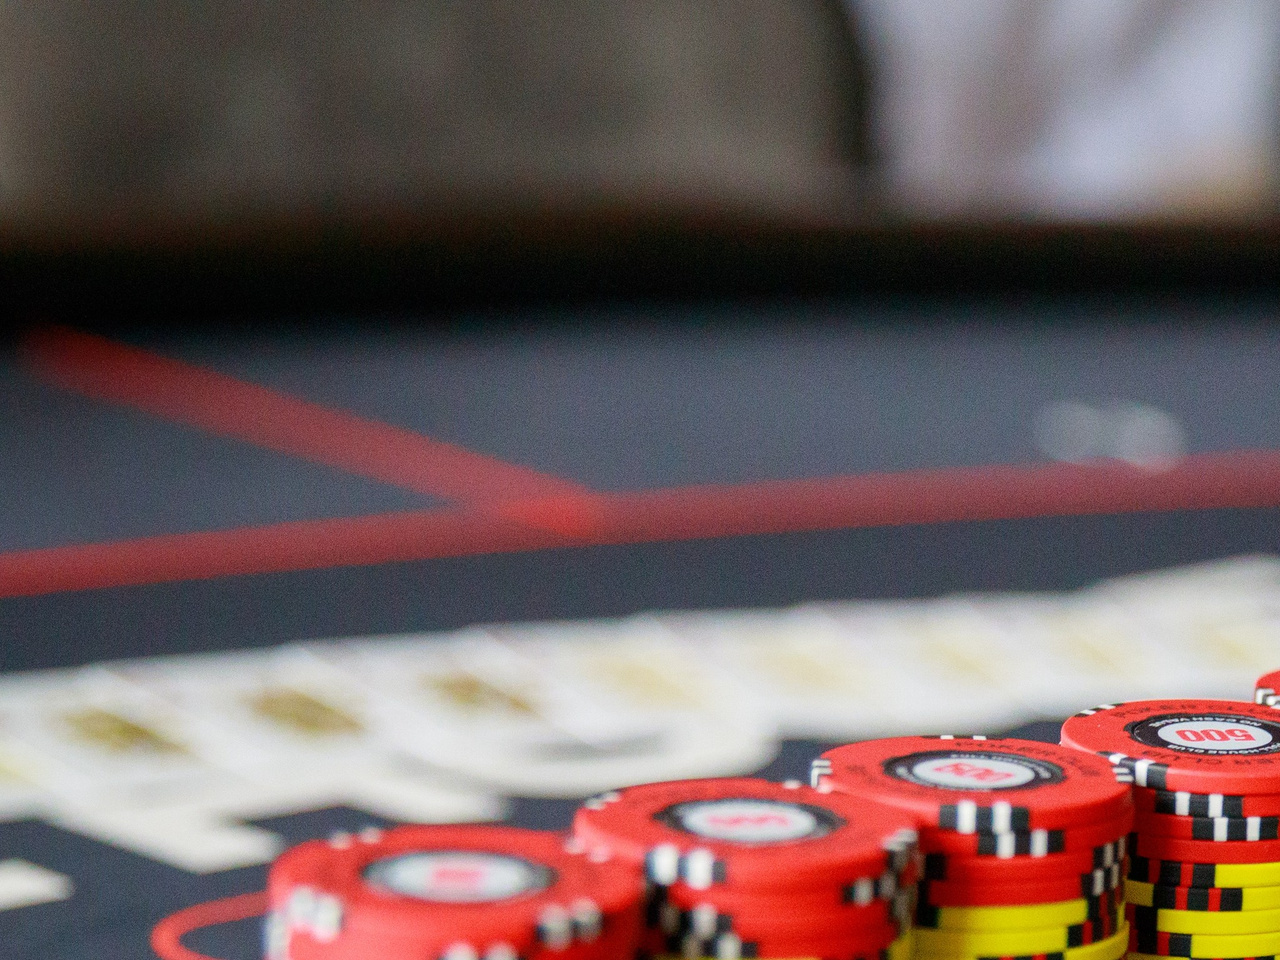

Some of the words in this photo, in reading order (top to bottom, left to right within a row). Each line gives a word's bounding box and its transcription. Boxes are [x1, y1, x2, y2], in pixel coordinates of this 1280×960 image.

[1239, 719, 1262, 727] NO
[1175, 728, 1256, 743] 500
[1167, 743, 1205, 754] CLUB
[1208, 747, 1259, 755] HOUSE
